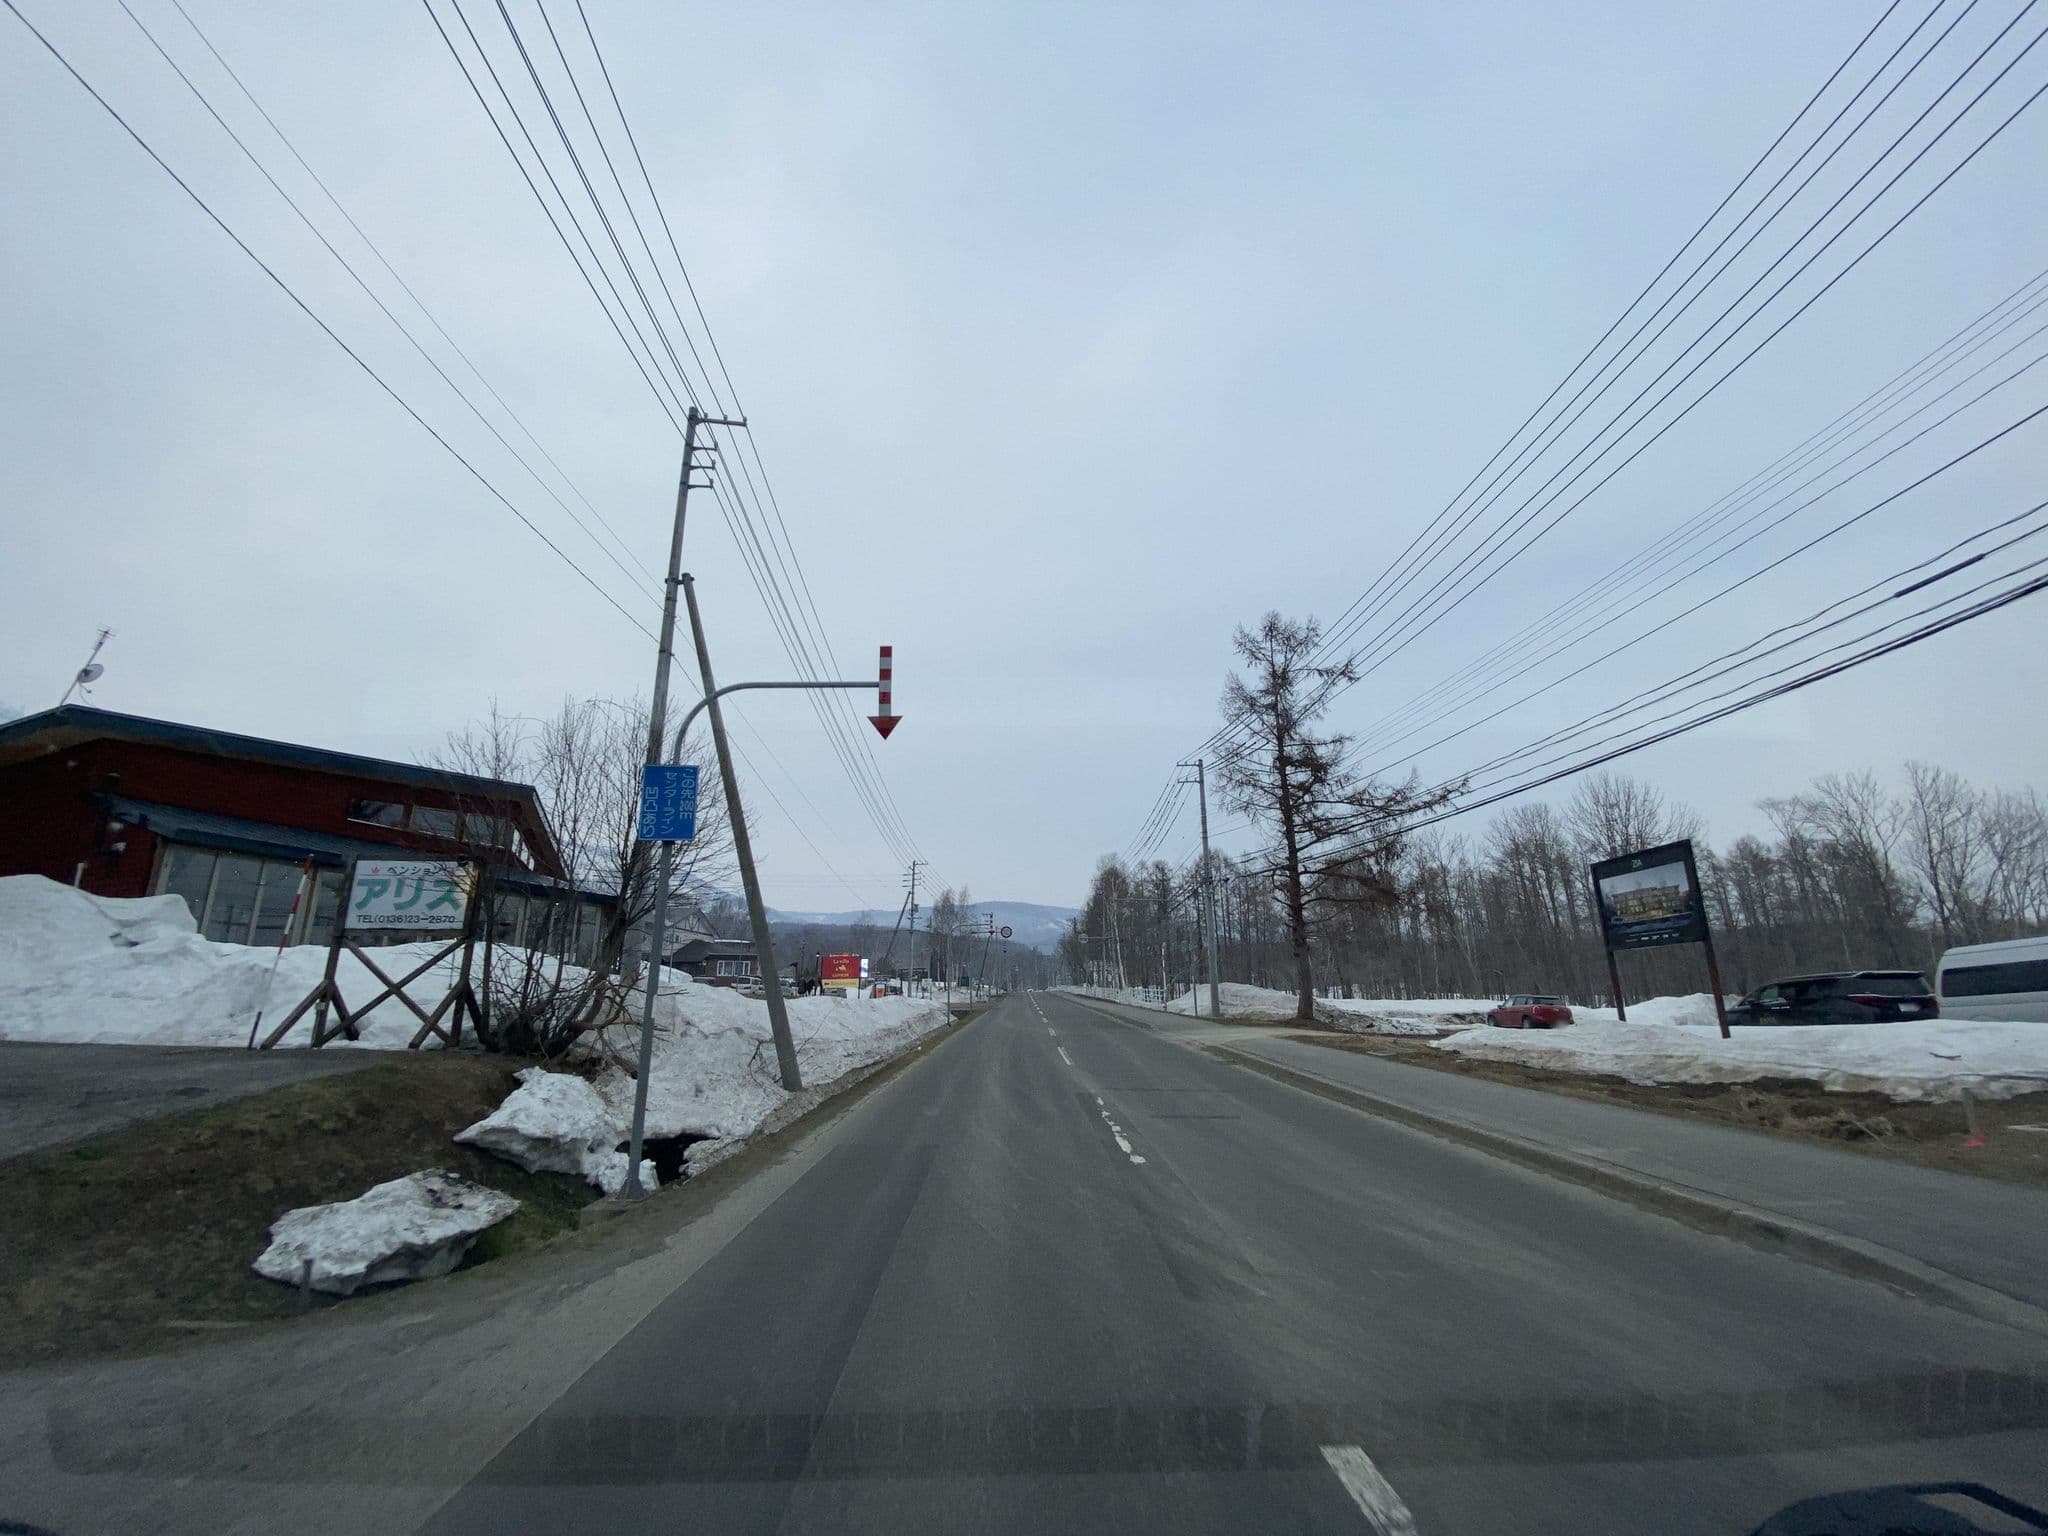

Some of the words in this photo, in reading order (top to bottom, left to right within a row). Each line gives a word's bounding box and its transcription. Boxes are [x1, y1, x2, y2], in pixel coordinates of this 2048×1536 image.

[642, 786, 659, 838] 凹凸あり
[659, 772, 678, 834] センターライン
[387, 865, 442, 875] ペンション
[355, 878, 461, 912] アリス
